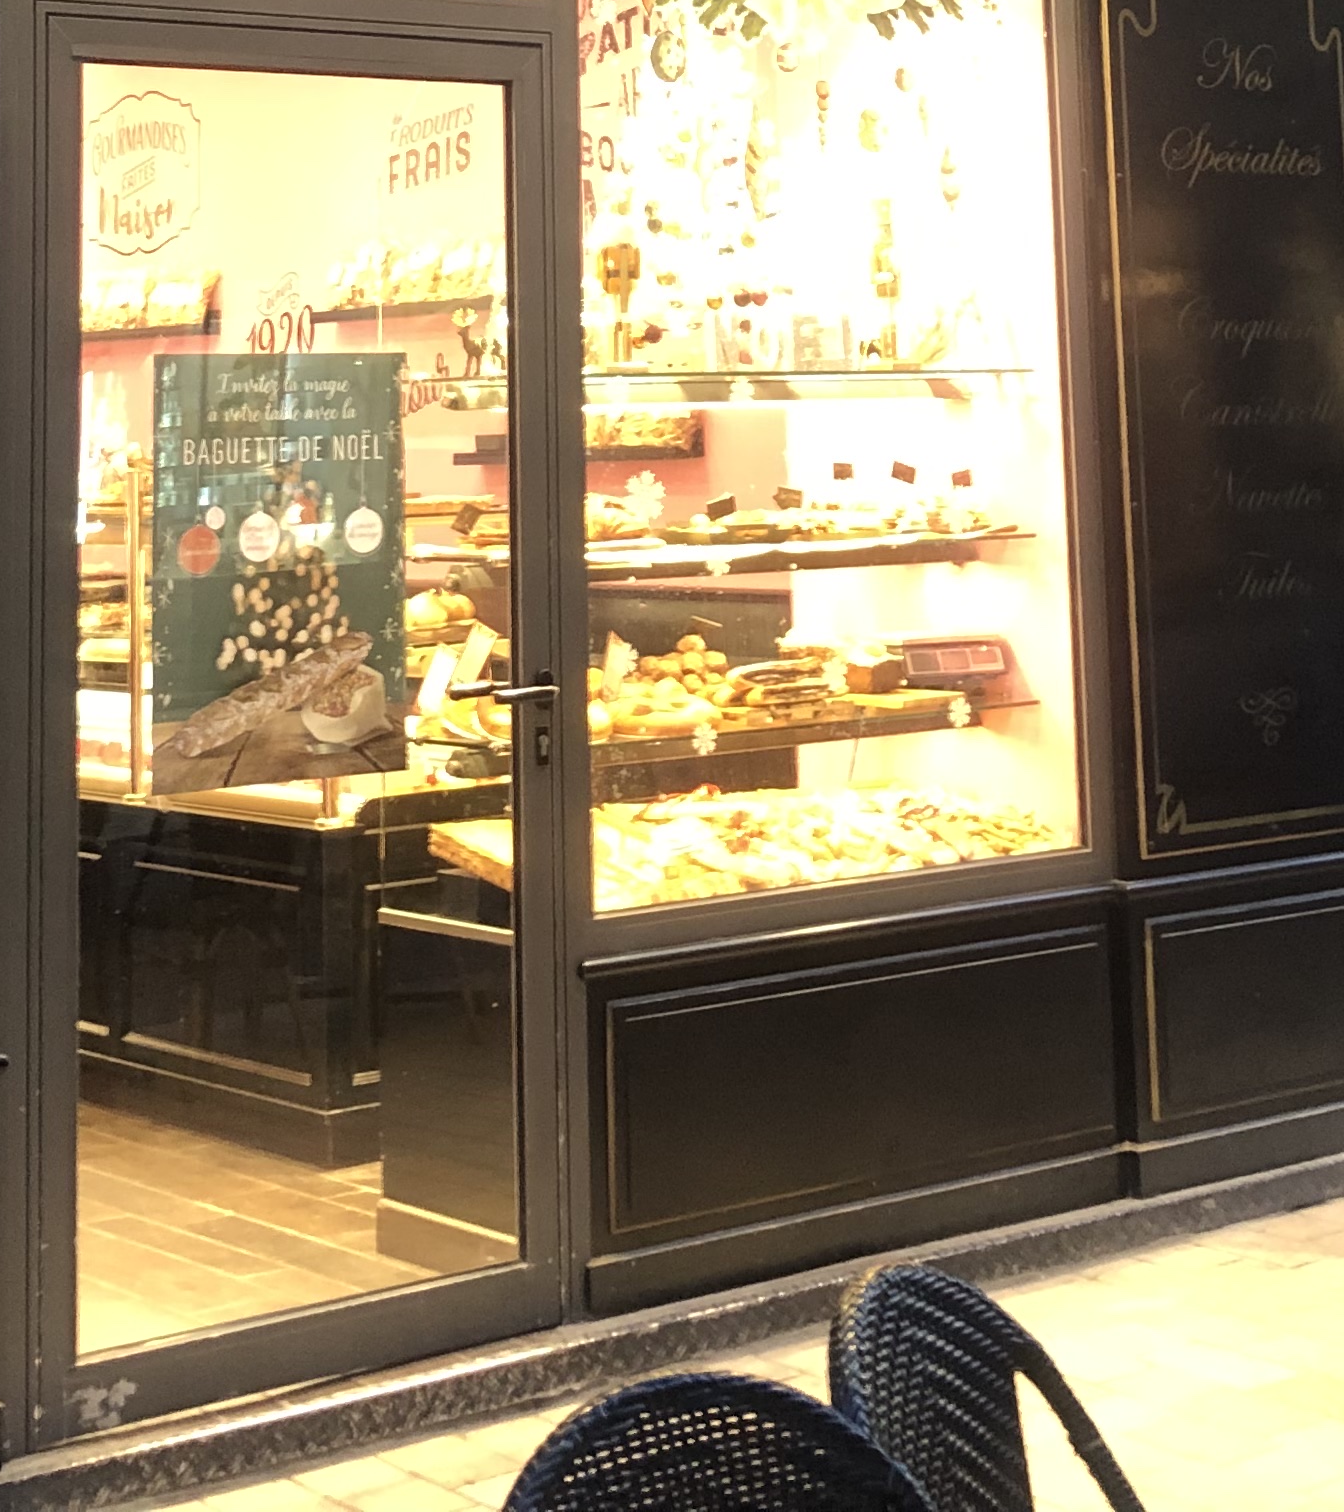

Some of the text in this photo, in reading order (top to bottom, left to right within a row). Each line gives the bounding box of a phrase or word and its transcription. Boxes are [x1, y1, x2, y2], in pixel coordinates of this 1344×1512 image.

[1195, 37, 1279, 93] Nos
[388, 130, 472, 195] FRAIS
[1160, 122, 1327, 189] Spécialités
[245, 304, 316, 355] 1920
[303, 378, 351, 401] magie
[182, 429, 384, 466] BAGUETTE DE NOËL
